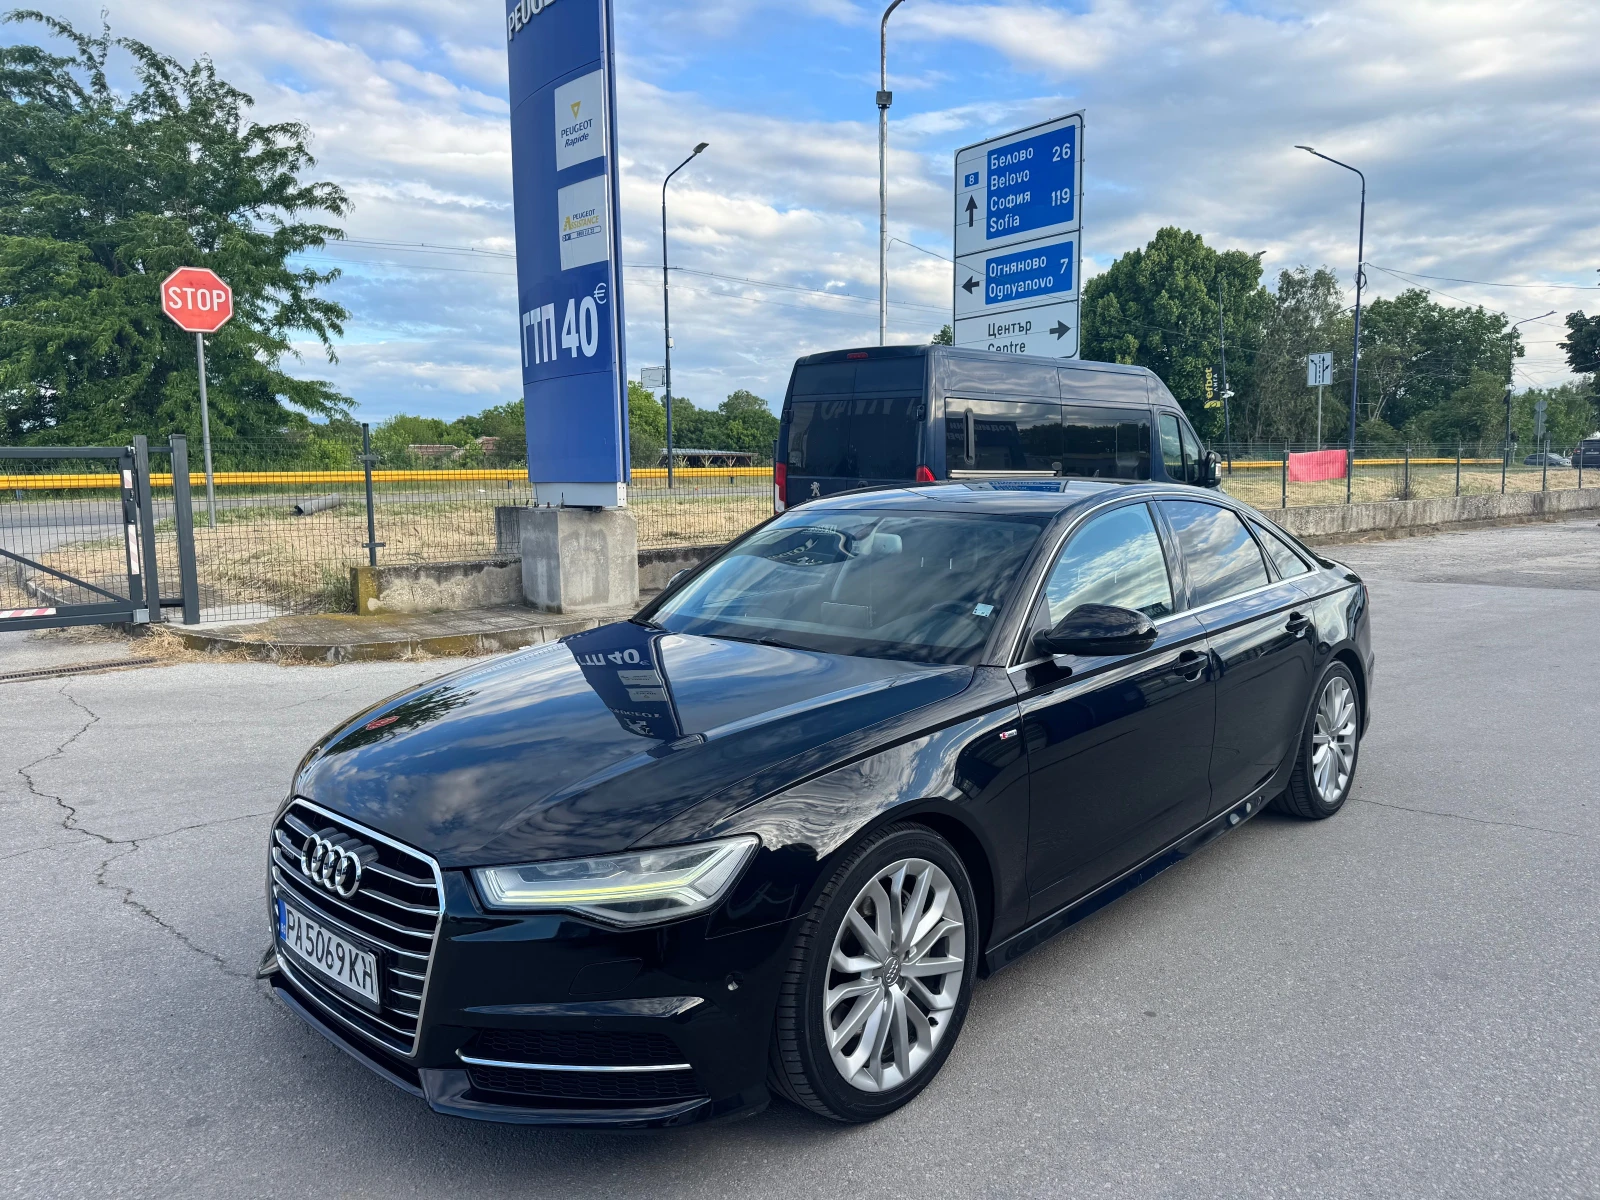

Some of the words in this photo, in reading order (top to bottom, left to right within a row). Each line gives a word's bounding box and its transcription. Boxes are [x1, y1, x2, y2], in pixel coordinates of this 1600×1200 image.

[561, 118, 593, 138] PEUGEOT
[565, 132, 589, 148] Rapide
[991, 147, 1034, 170] Белово
[1052, 143, 1071, 162] 26
[968, 174, 975, 185] 8
[991, 170, 1030, 190] Belovo
[990, 191, 1031, 211] София
[1051, 188, 1070, 206] 119
[572, 209, 596, 220] PEUGEOT
[990, 213, 1020, 232] Sofia
[989, 256, 1047, 277] Огняново
[1060, 258, 1069, 274] 7
[989, 276, 1054, 299] Ognyanovo
[168, 286, 226, 312] STOP
[522, 302, 557, 368] ГТП
[987, 320, 1032, 338] Център
[1204, 366, 1213, 399] efbet
